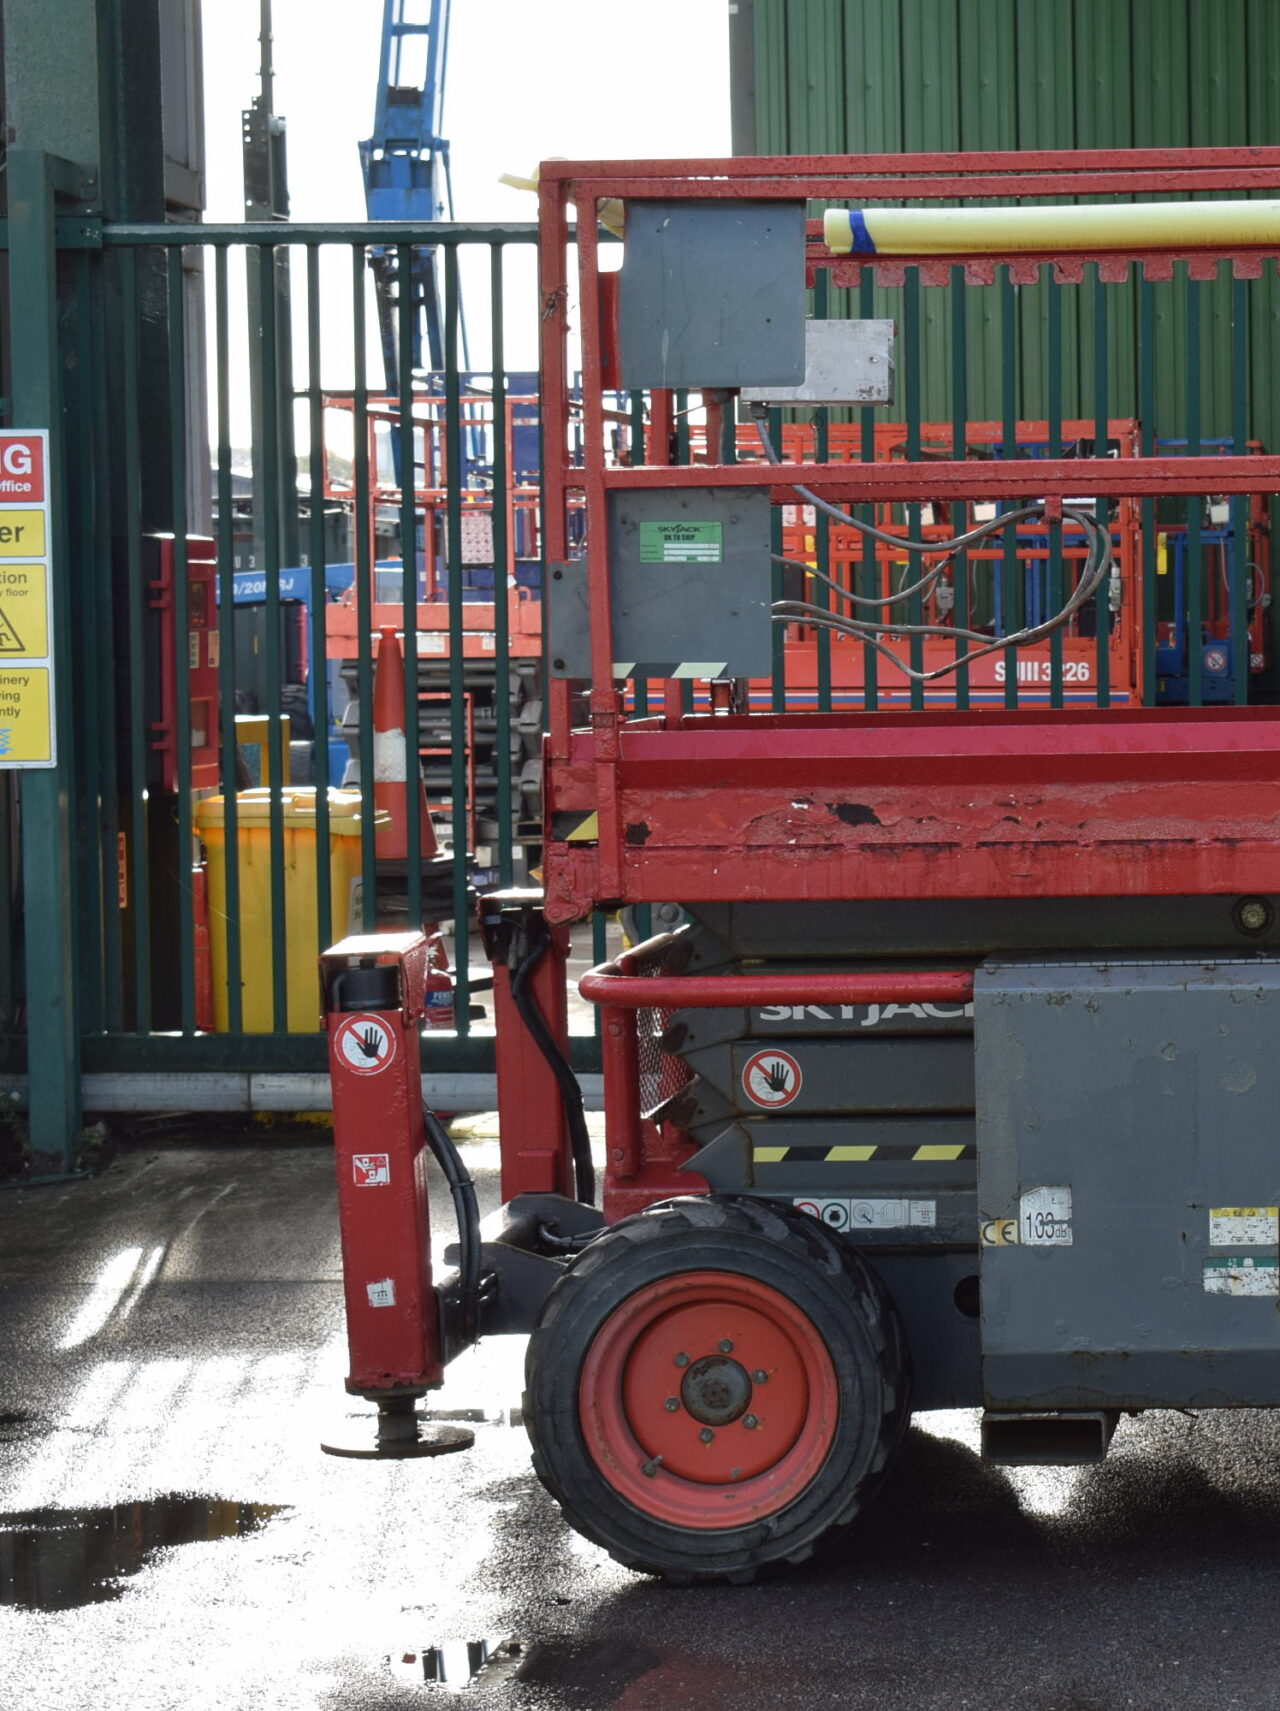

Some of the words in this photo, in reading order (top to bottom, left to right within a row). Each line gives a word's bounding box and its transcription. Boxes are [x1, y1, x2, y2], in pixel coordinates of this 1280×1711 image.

[0, 443, 32, 475] G
[0, 480, 32, 492] ffice
[995, 661, 1039, 681] SIII
[1042, 661, 1090, 681] 326
[0, 690, 20, 703] ing
[760, 1003, 975, 1026] SKYJAC
